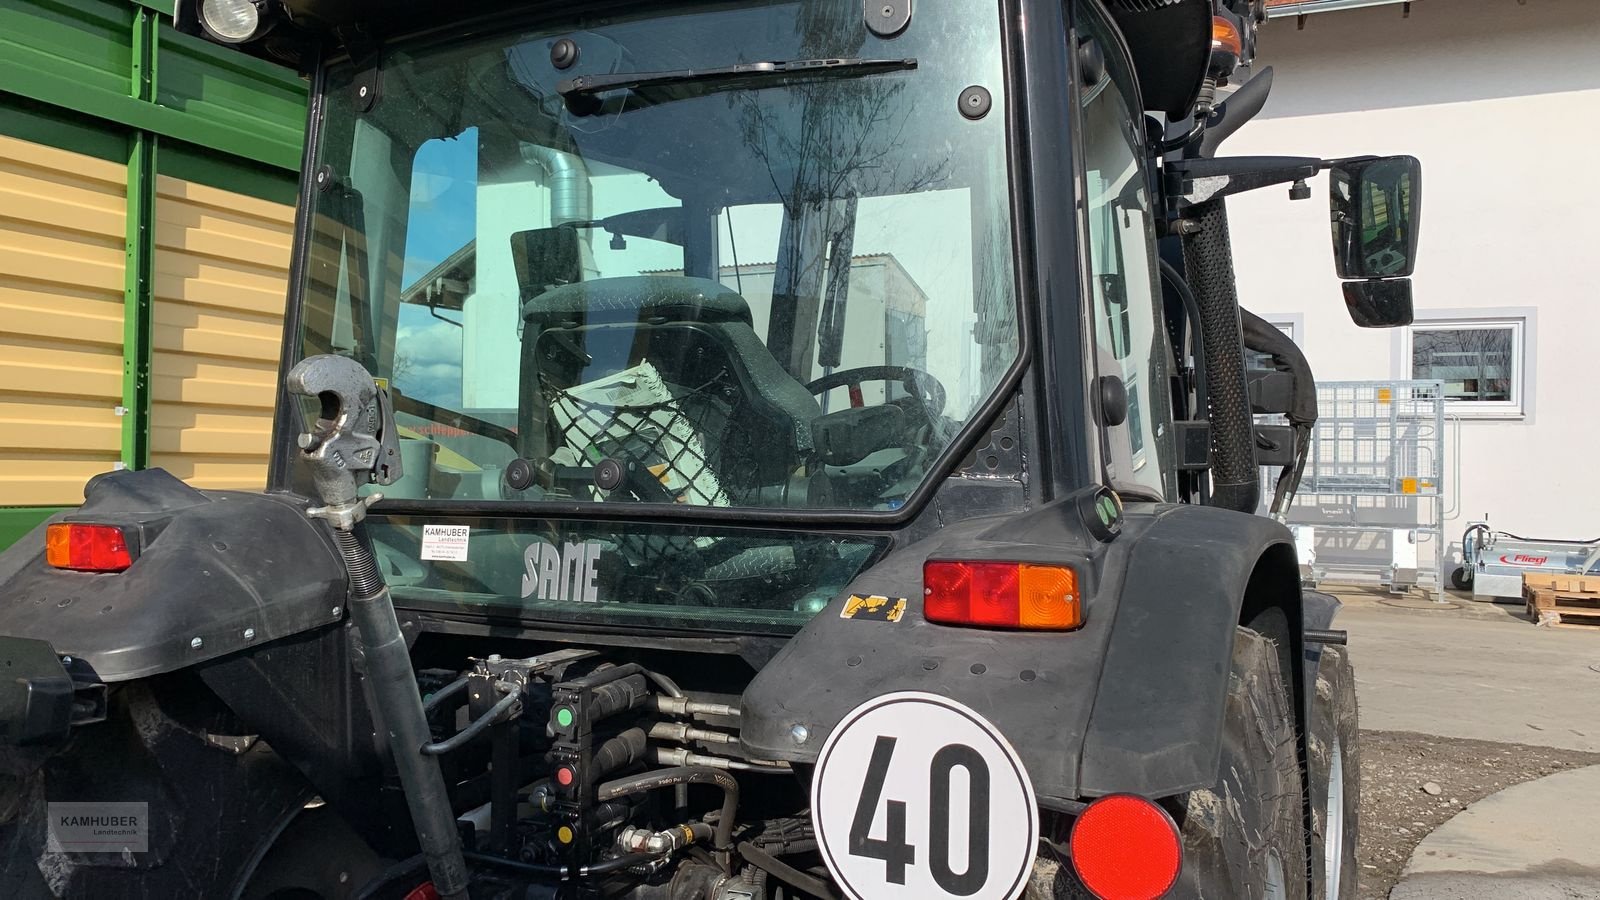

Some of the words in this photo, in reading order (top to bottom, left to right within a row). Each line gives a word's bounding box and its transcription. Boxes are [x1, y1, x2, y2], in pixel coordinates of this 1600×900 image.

[425, 528, 467, 536] KAMHUBER
[521, 542, 600, 602] SAME
[1514, 554, 1547, 565] Fliegl
[849, 735, 990, 896] 40
